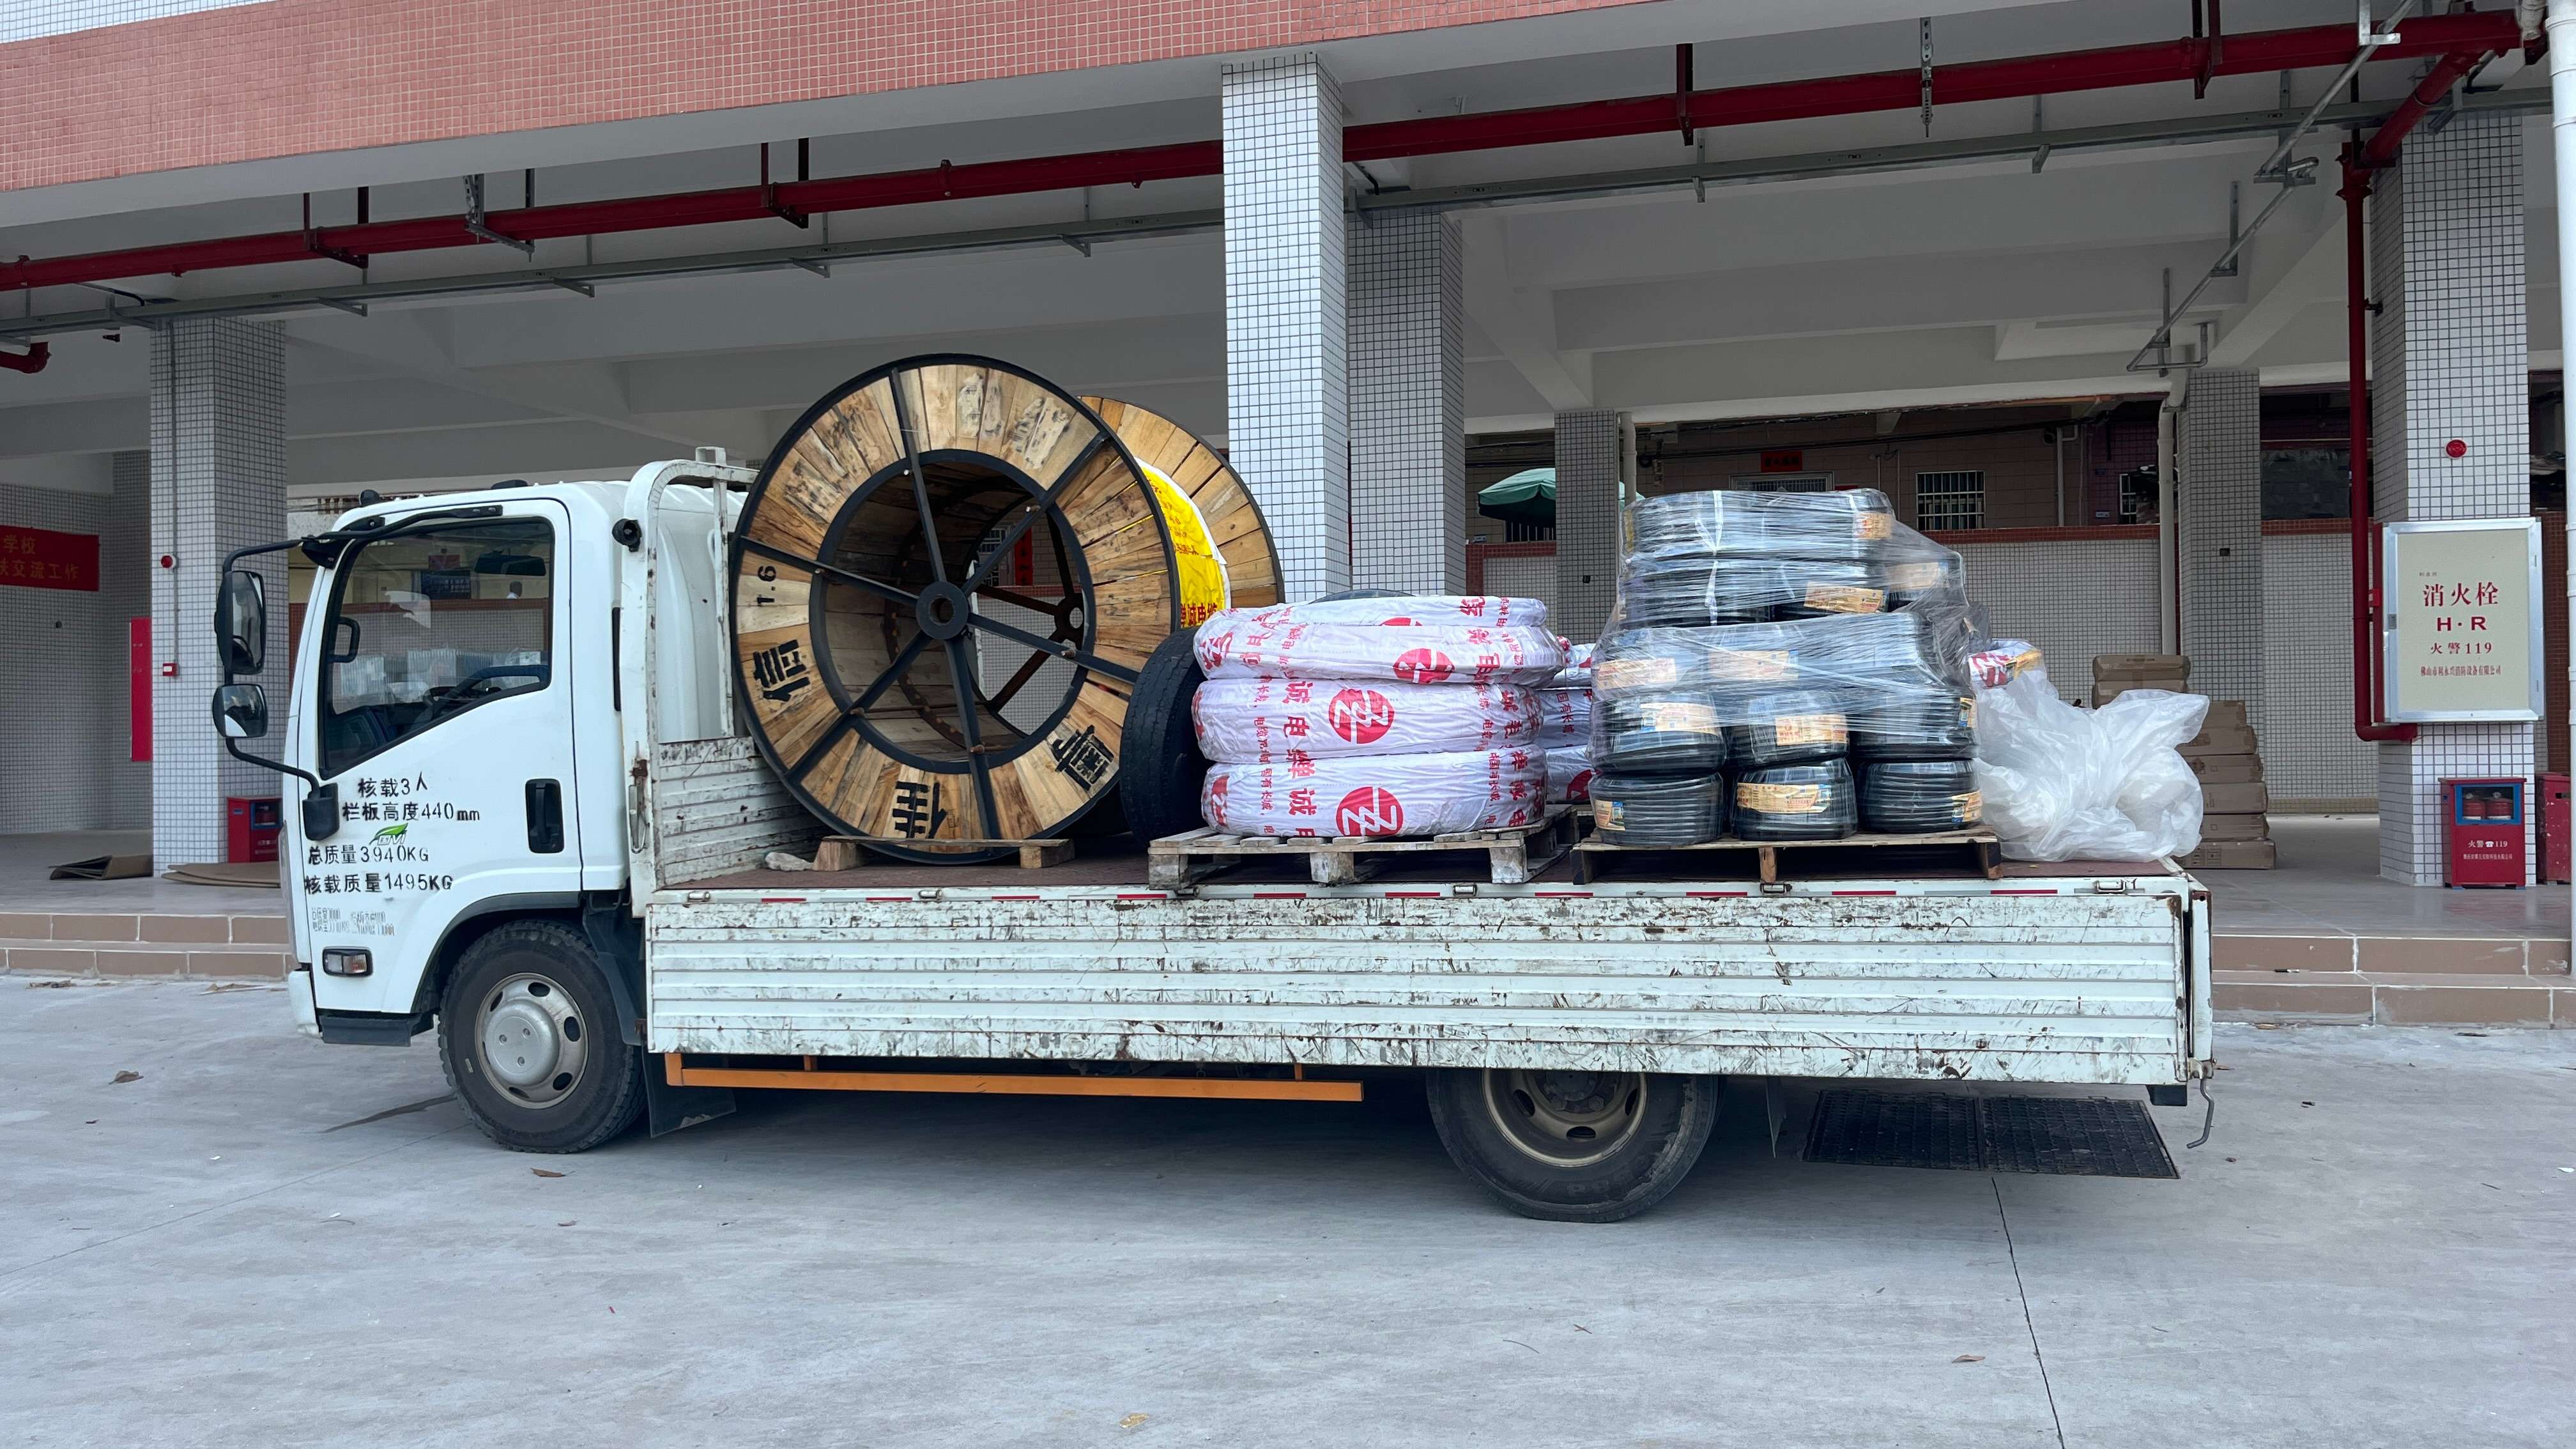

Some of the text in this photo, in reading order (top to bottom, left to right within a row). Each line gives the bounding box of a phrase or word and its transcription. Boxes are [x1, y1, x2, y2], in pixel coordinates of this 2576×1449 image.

[3, 534, 36, 555] 学校
[757, 565, 776, 607] 1.6
[2423, 581, 2499, 607] 消火栓
[753, 638, 813, 703] 信
[358, 771, 428, 798] 核载3人
[342, 801, 480, 822] 栏板高度440mm
[893, 781, 949, 838] 佳
[308, 844, 429, 865] 总质量3940KG
[304, 873, 454, 895] 核载质量1495KG
